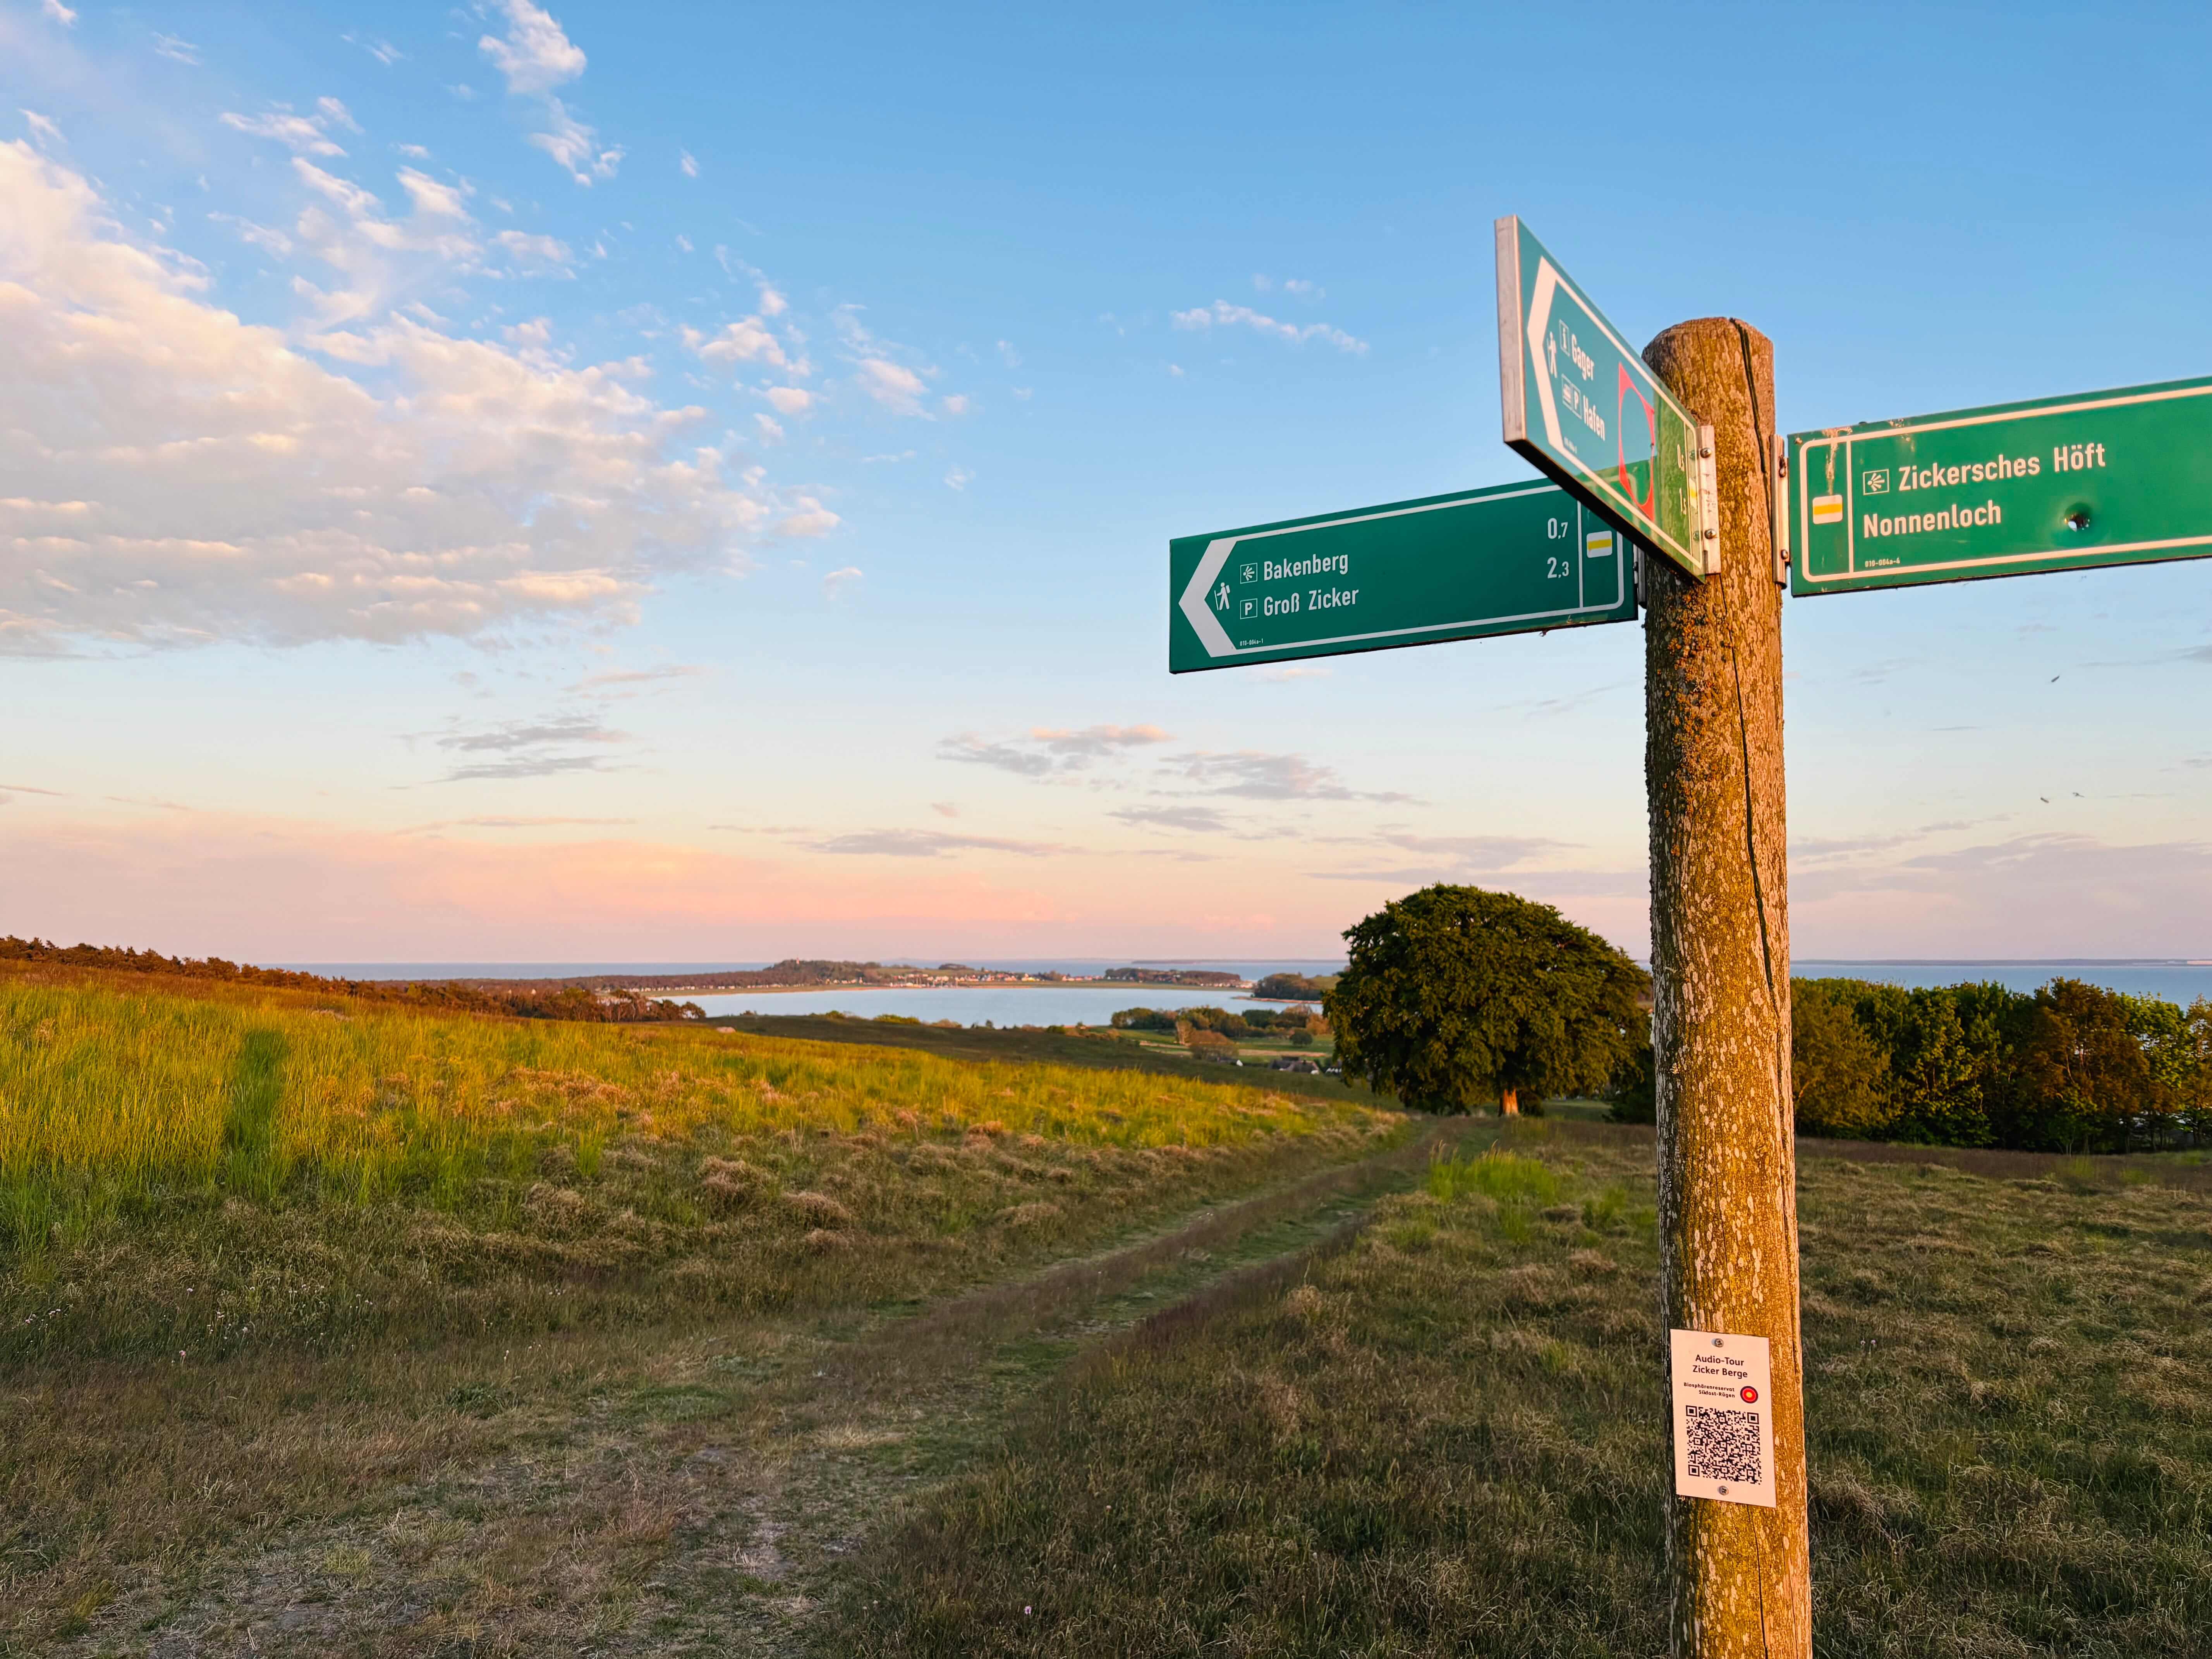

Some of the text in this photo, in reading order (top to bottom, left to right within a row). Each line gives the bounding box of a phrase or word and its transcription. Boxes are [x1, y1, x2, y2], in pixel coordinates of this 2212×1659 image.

[1571, 333, 1594, 381] Gager
[1583, 395, 1605, 441] Hafen
[1899, 443, 2106, 491] Zickersches Höft
[1547, 518, 1568, 539] 0,7
[1863, 500, 2001, 538] Nonnenloch
[1264, 554, 1348, 581] Bakenberg
[1547, 557, 1569, 579] 2,3
[1245, 587, 1359, 616] P Groß Zicker
[1692, 1365, 1748, 1379] Zicker Berge
[1695, 1354, 1744, 1366] Audio-Tour
[1683, 1382, 1735, 1391] Biosphärenreservat
[1698, 1390, 1735, 1398] Südost-Rügen
